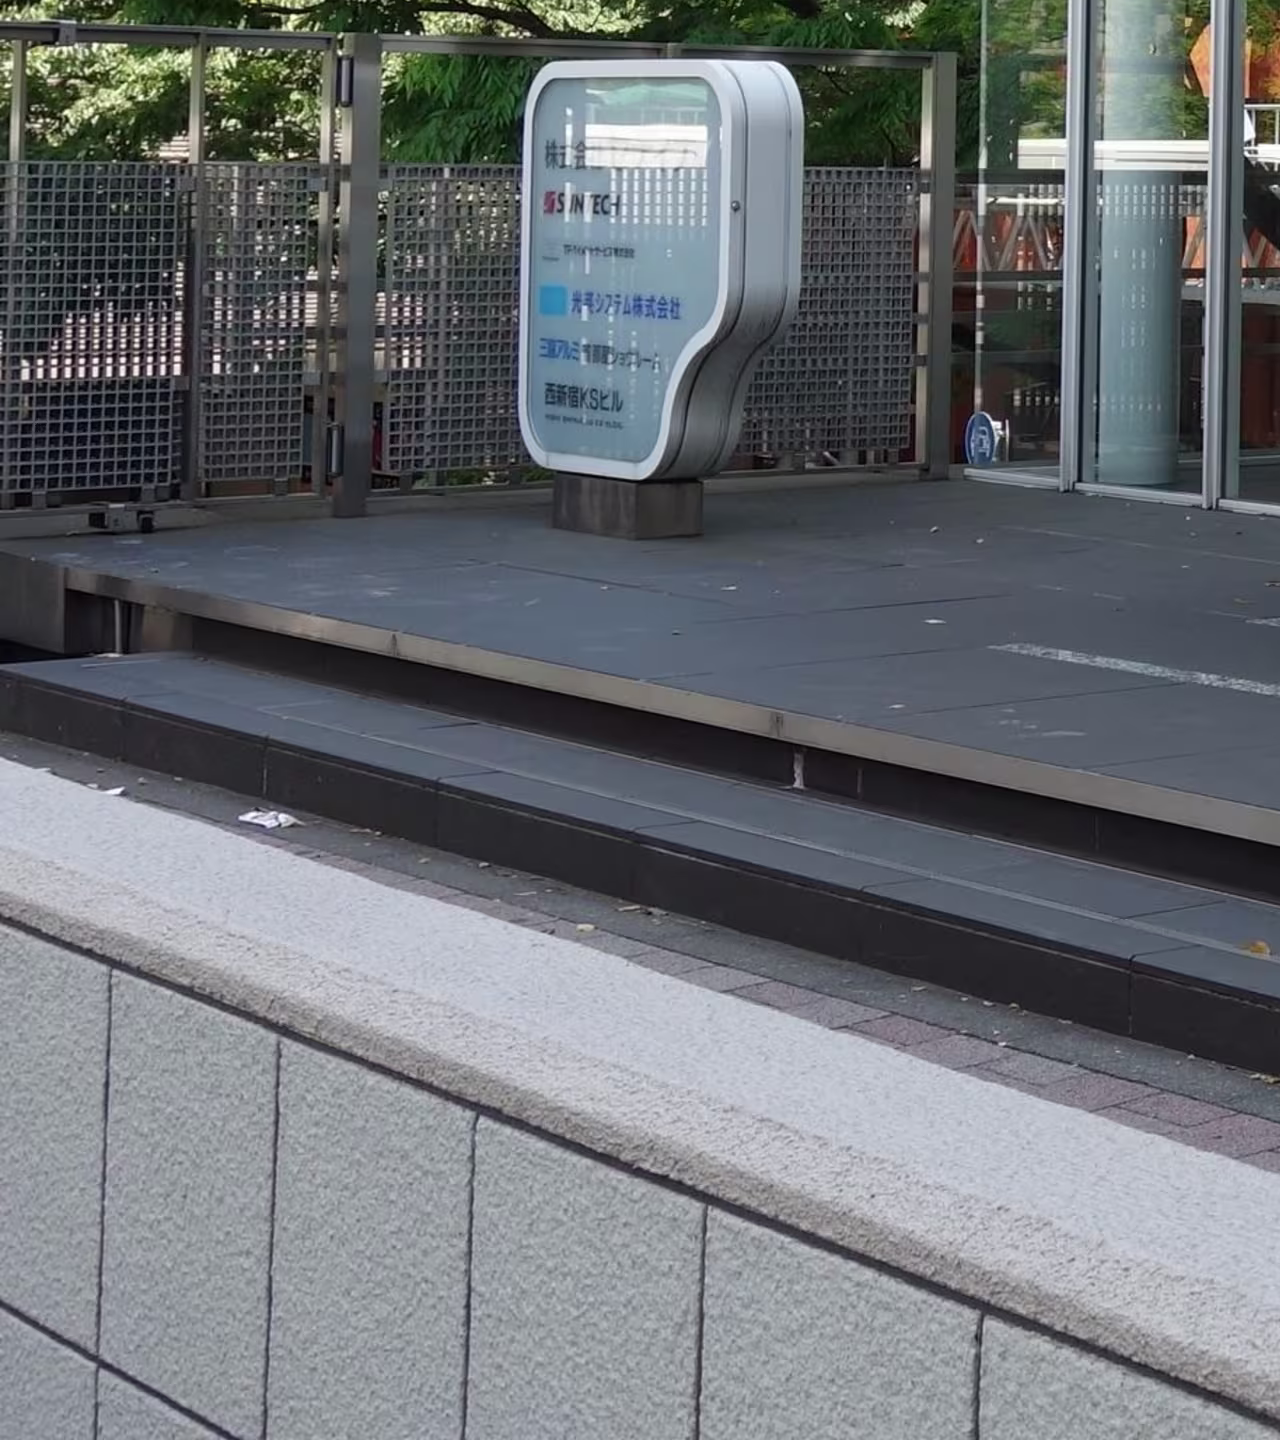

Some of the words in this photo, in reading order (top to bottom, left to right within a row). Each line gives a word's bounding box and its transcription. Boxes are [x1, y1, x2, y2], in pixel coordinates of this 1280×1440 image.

[544, 382, 625, 413] 西新宿KSビル
